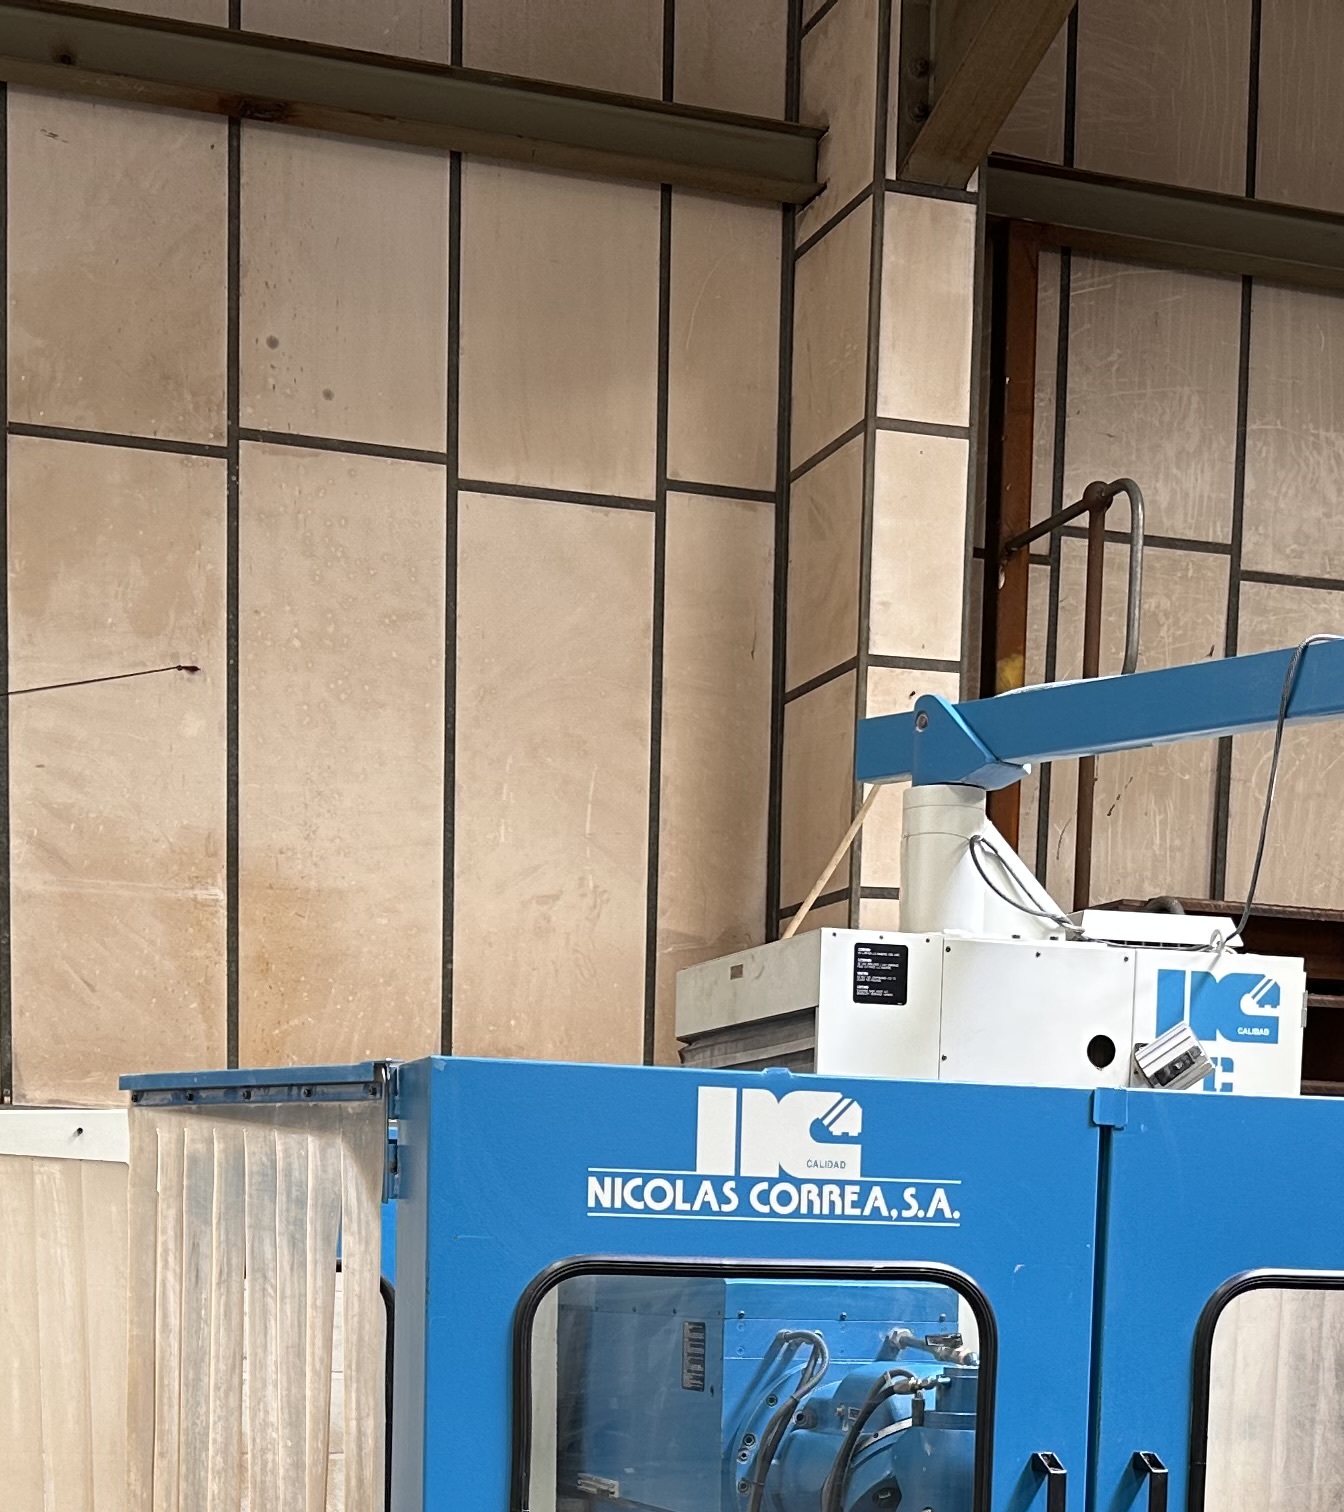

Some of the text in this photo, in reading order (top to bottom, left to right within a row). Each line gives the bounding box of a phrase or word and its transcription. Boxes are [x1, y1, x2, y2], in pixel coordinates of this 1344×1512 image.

[1237, 1026, 1270, 1036] CALIDAD
[806, 1158, 846, 1169] CALIDAD
[587, 1175, 739, 1213] NICOLAS
